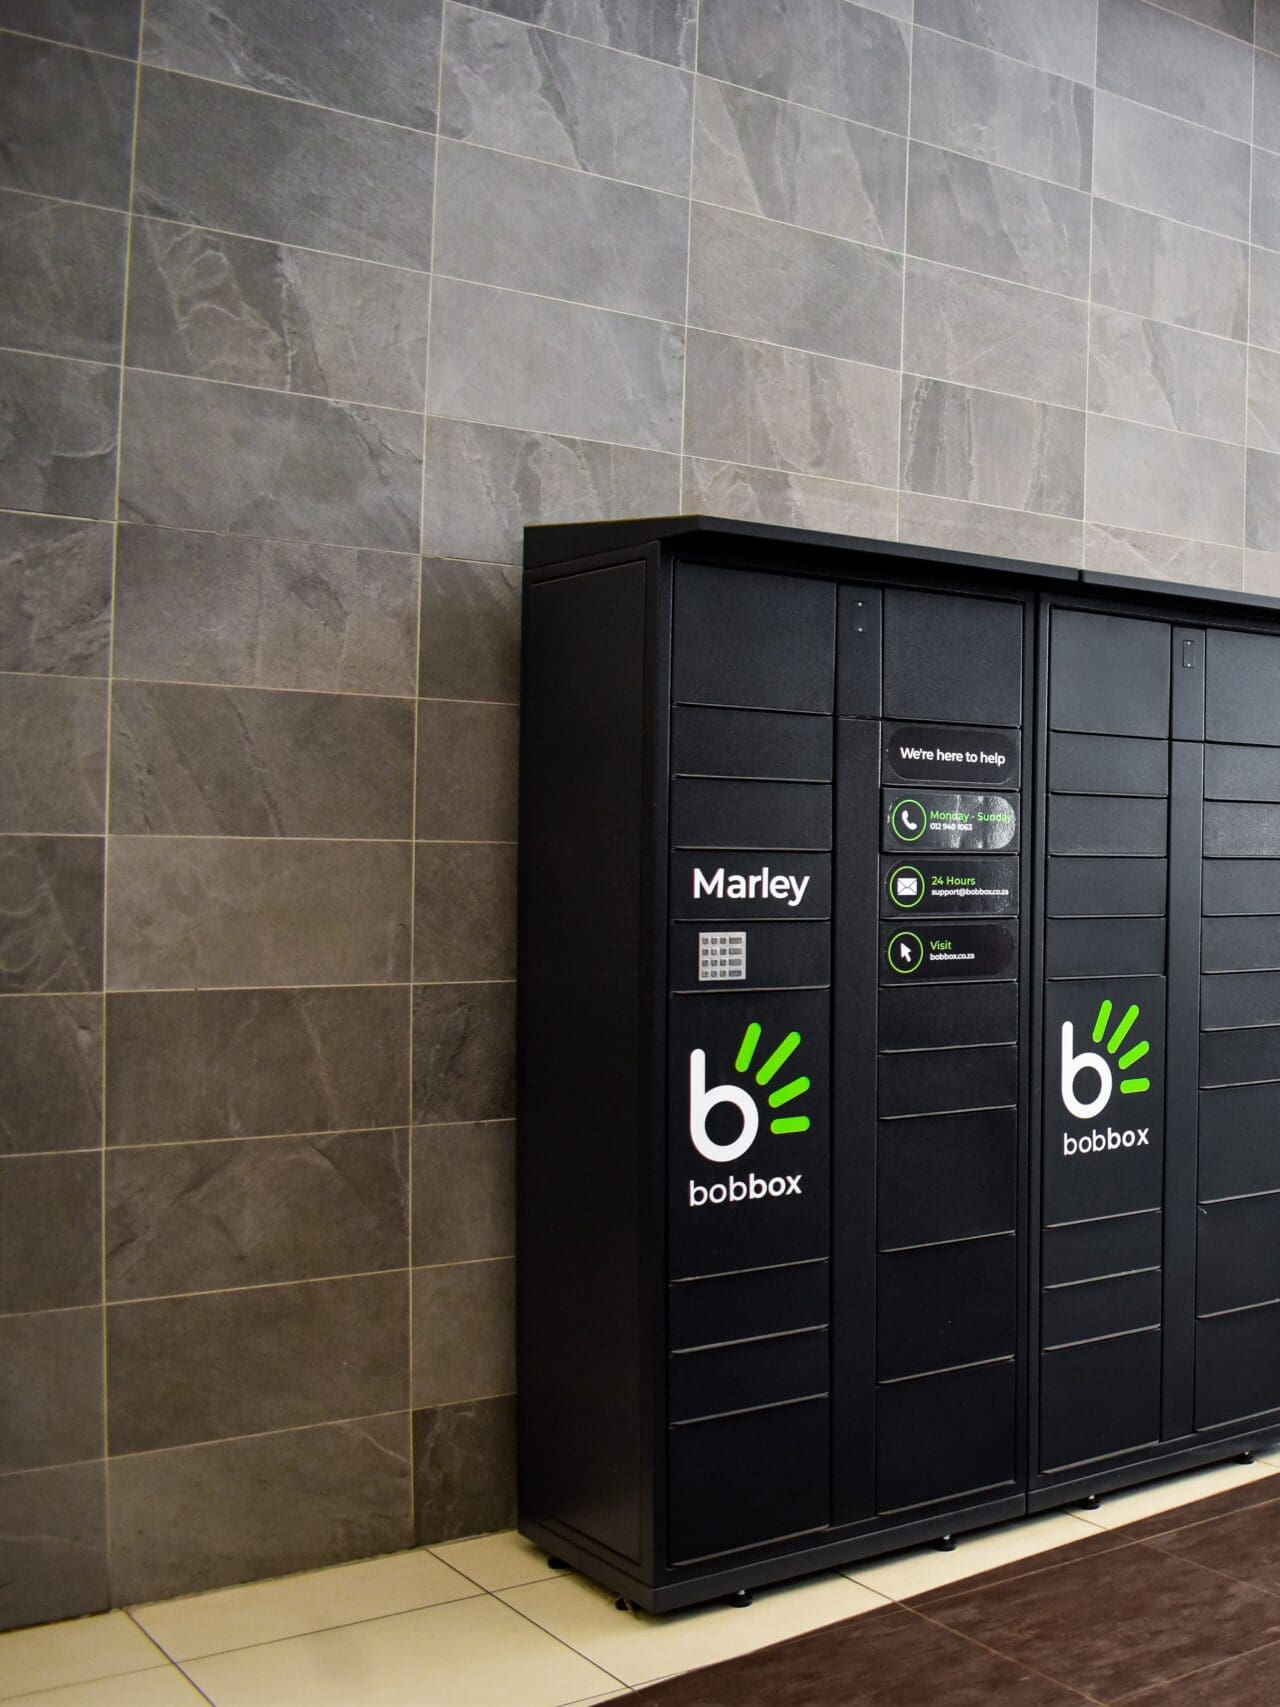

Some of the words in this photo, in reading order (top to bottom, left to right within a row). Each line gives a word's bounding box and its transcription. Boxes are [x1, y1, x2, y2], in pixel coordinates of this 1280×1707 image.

[900, 747, 934, 760] We're
[937, 748, 963, 762] here
[965, 751, 978, 763] to
[980, 751, 1006, 767] help
[930, 811, 970, 823] Monday
[977, 812, 1012, 824] Sunday
[929, 822, 942, 830] 012
[931, 876, 944, 886] 24
[946, 876, 976, 886] Hours
[693, 867, 810, 907] Marley
[931, 888, 1009, 897] support@bobbox.co.za
[930, 940, 952, 950] Visit
[929, 953, 975, 961] bobbox.co.za
[1063, 1126, 1150, 1156] bobbox
[689, 1173, 802, 1207] bobbox
